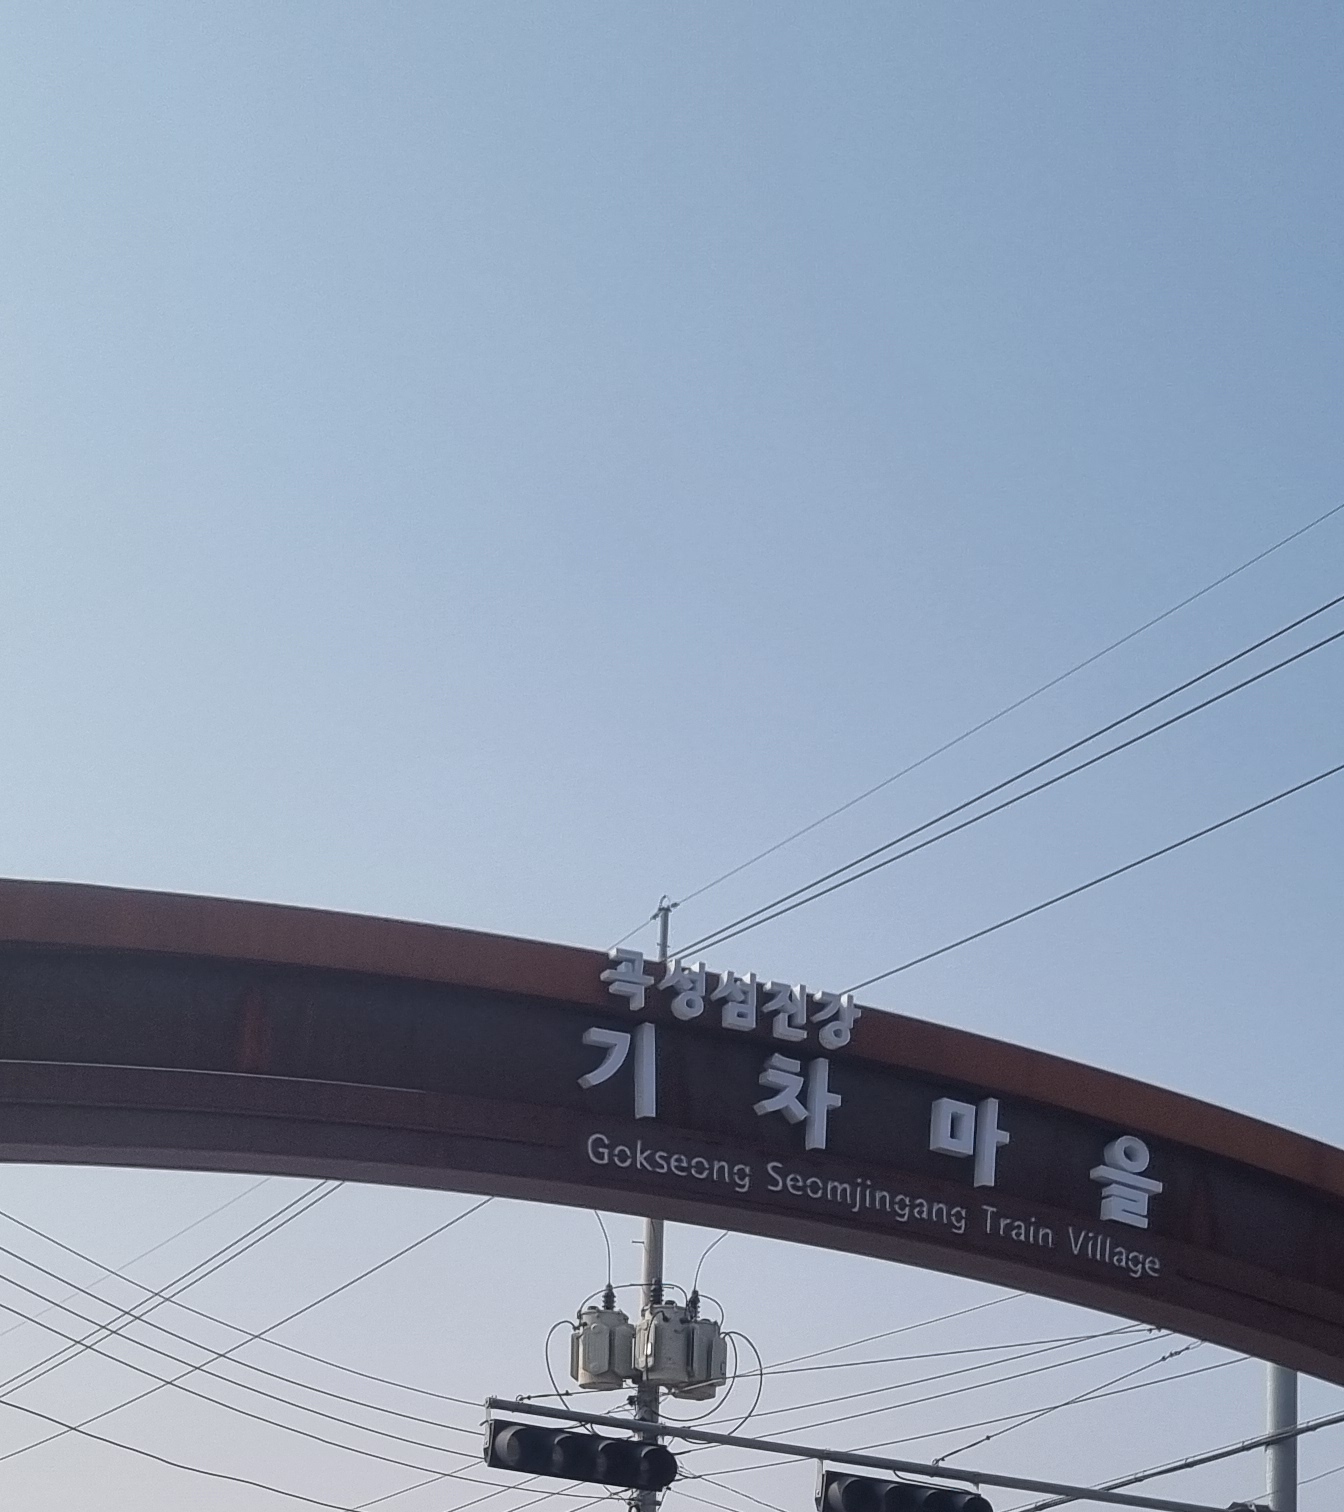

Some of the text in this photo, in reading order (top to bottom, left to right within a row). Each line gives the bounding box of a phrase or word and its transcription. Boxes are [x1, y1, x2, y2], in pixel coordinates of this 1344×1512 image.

[601, 948, 860, 1050] 곡성섬진강
[587, 1133, 1161, 1277] Gokseong Seomjingang Train Village
